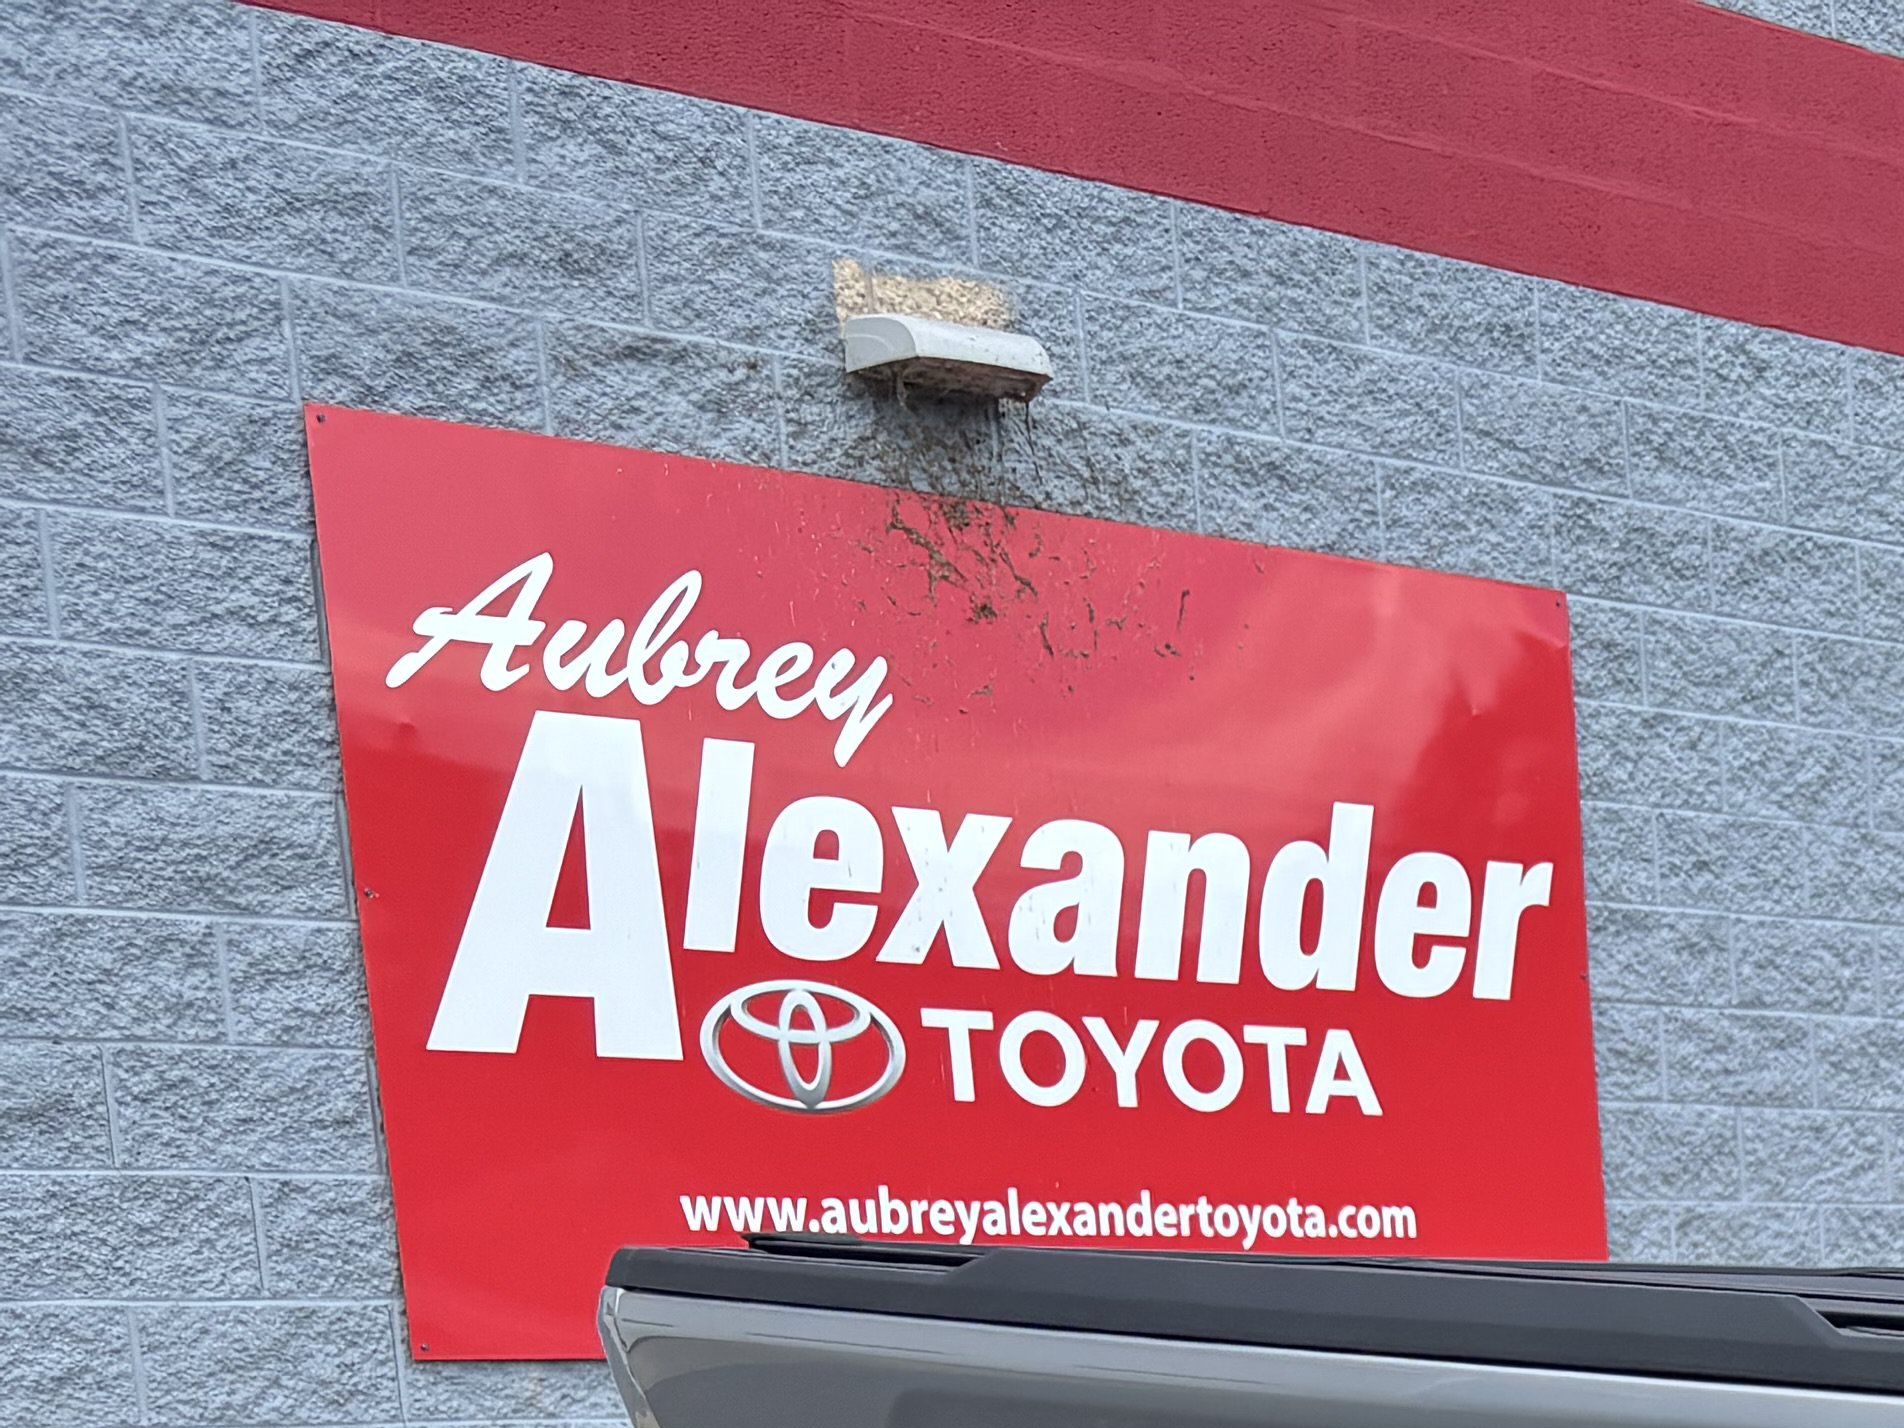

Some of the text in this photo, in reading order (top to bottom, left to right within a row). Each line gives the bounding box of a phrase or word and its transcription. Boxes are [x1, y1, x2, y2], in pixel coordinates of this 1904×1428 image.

[385, 552, 894, 768] Aubrey
[425, 710, 1554, 1061] Alexander
[920, 1007, 1384, 1117] TOYOTA
[680, 1187, 1418, 1250] www.aubreyalexandertoyota.com
